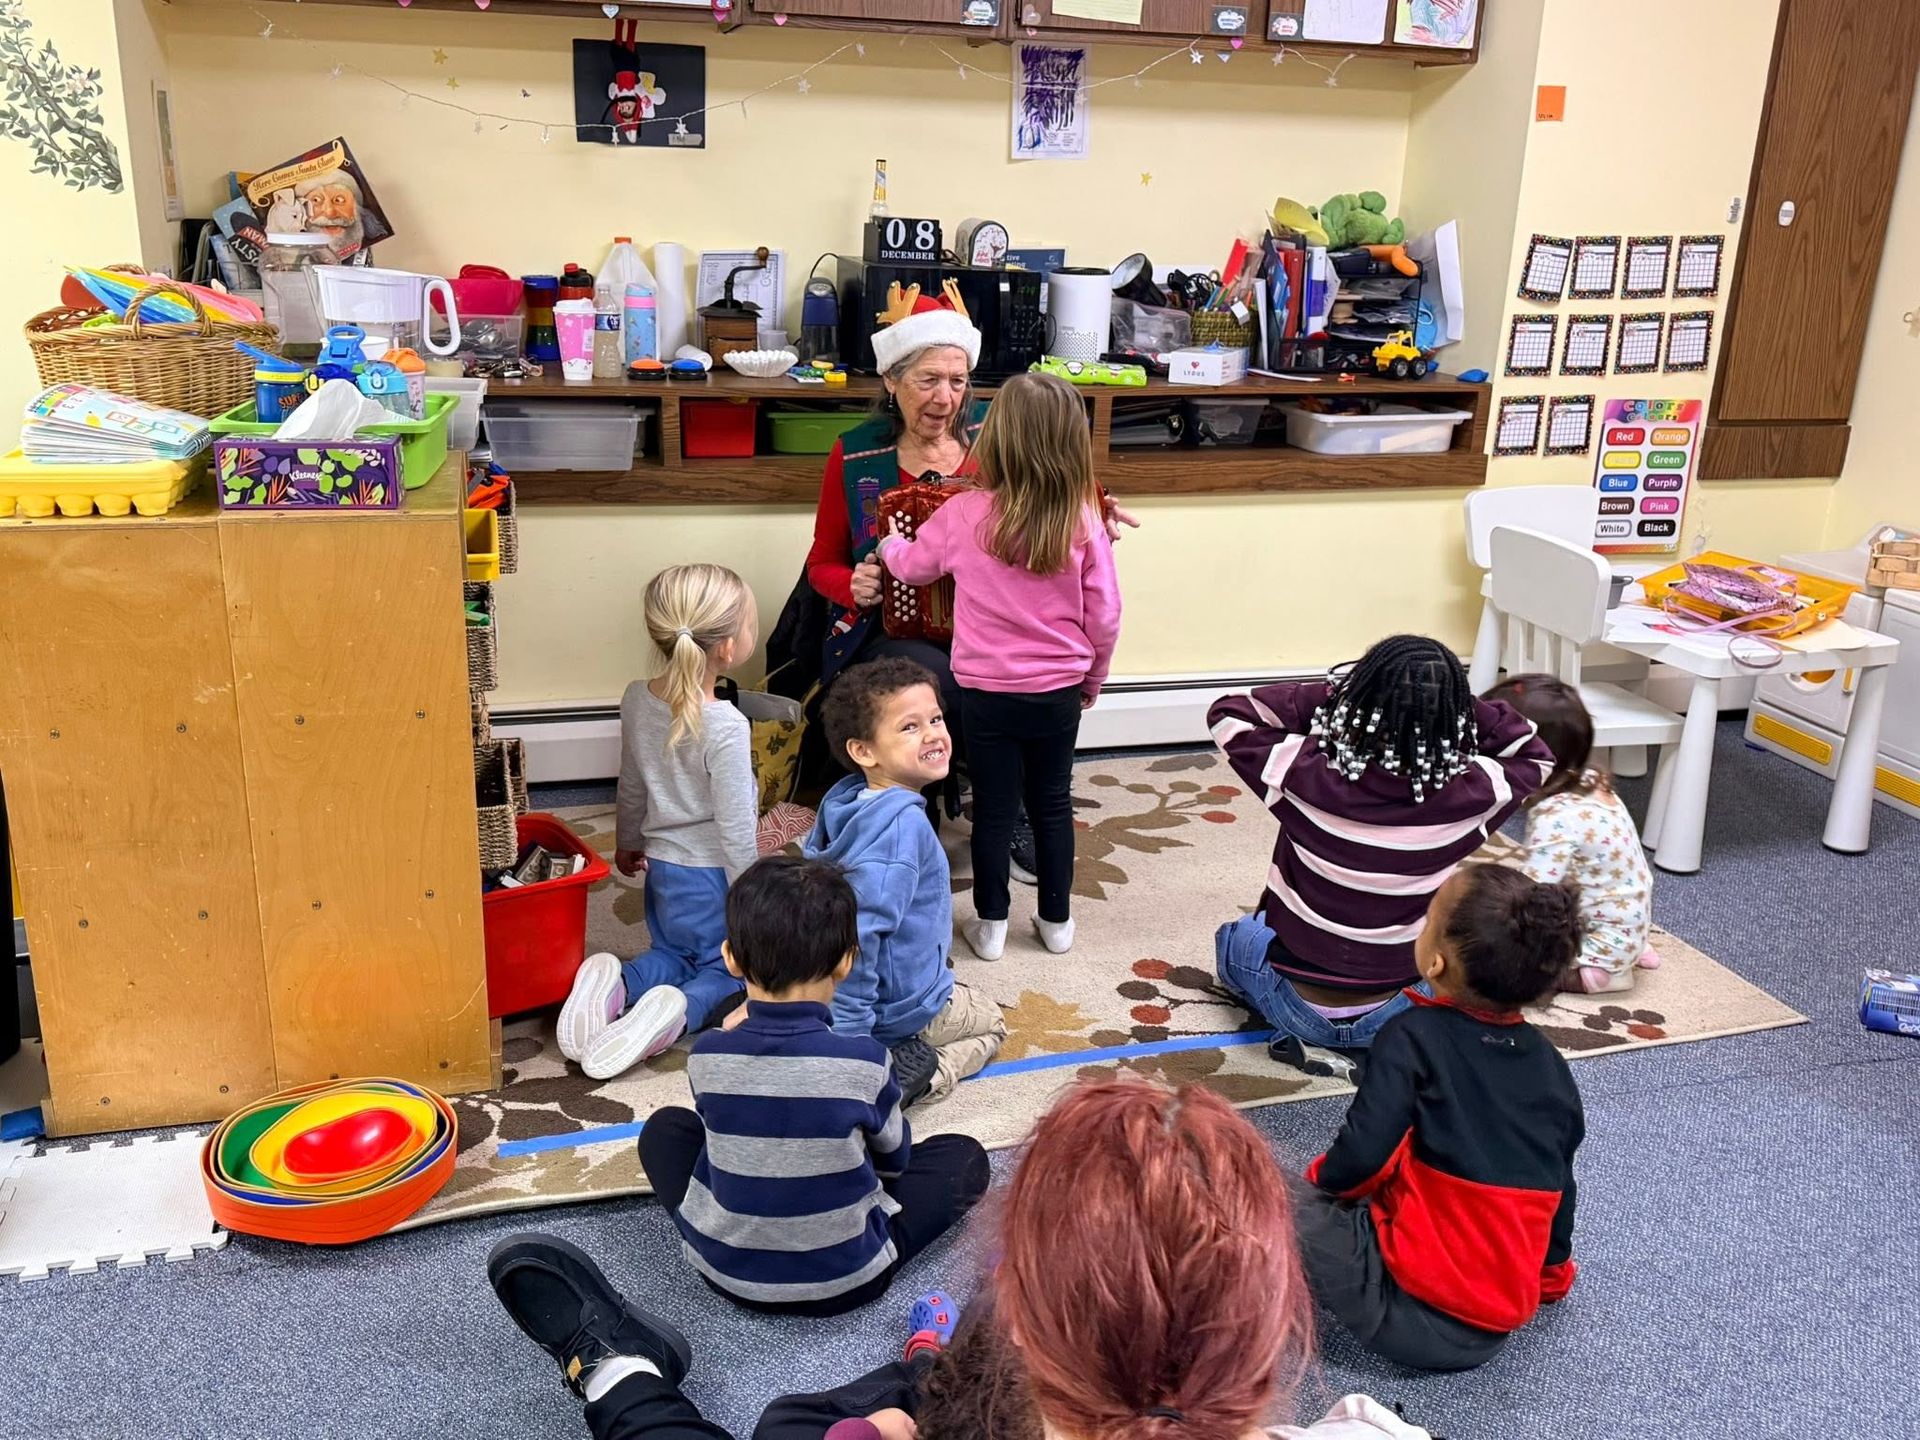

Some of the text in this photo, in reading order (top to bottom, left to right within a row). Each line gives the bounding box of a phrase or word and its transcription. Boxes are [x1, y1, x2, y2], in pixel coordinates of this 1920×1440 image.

[252, 155, 336, 191] Here Comes Santa Claus
[231, 238, 260, 267] OSTY
[881, 250, 935, 261] DECEMBER
[1616, 432, 1634, 441] Red
[1655, 432, 1687, 442] Orange
[1653, 455, 1680, 464] Green
[289, 470, 322, 482] Kleenex
[1608, 478, 1628, 487] Blue
[1648, 478, 1678, 489] Purple
[1601, 501, 1630, 511] Brown
[1650, 502, 1669, 511] Pink
[1600, 524, 1625, 533] White
[1644, 523, 1669, 532] Black
